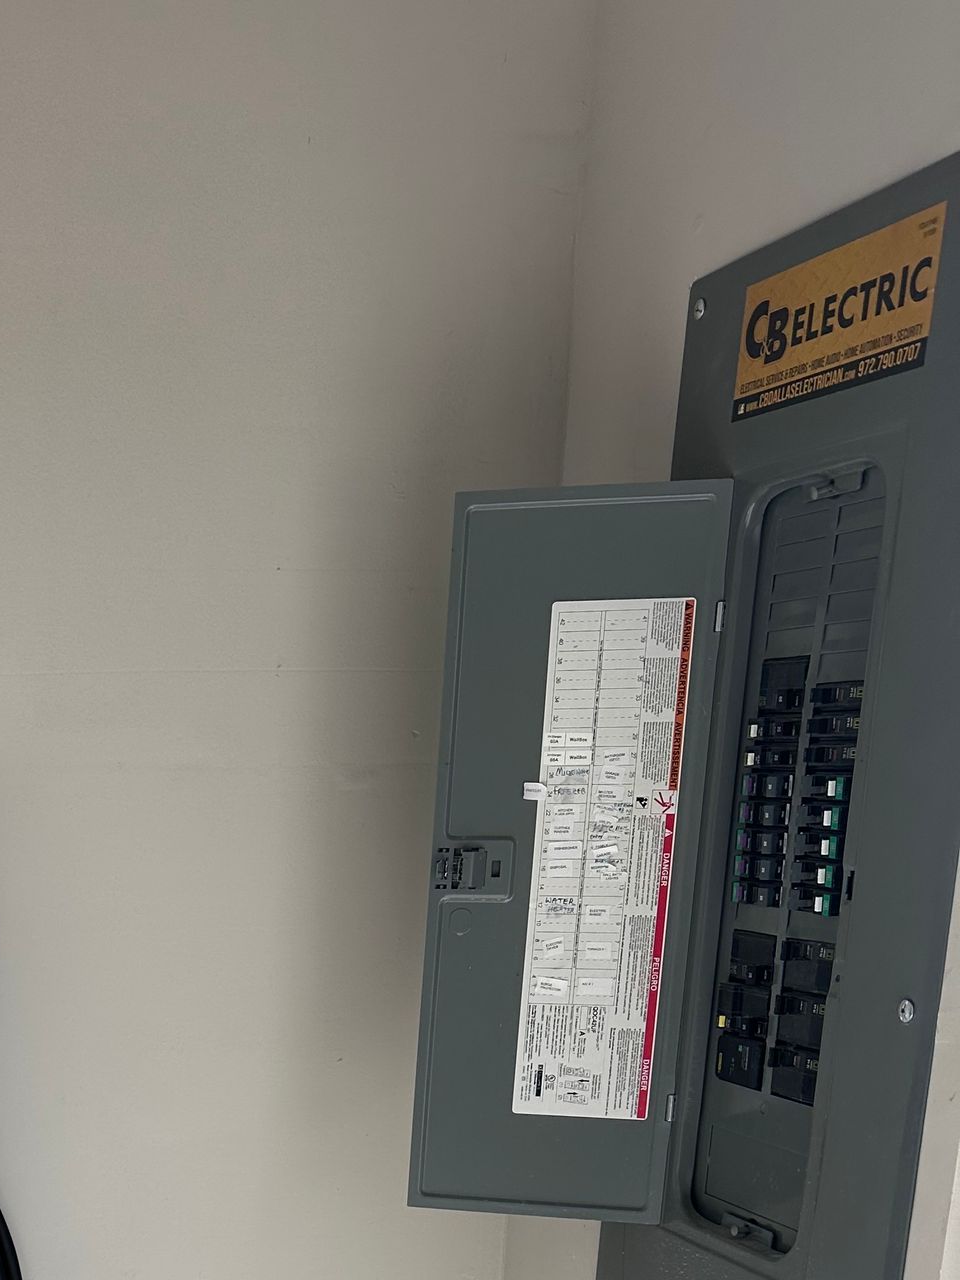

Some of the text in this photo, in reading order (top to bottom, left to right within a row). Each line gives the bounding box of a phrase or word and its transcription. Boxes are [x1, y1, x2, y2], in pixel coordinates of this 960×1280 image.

[790, 256, 933, 347] ELECTRIC
[857, 342, 921, 377] 972.790.0707
[669, 611, 693, 789] WARNING ADVERTENCIA AVERTISSEMENT
[660, 853, 670, 887] DANGER
[545, 897, 577, 906] WATER
[650, 956, 660, 992] PELIGRO
[640, 1059, 650, 1091] DANGER
